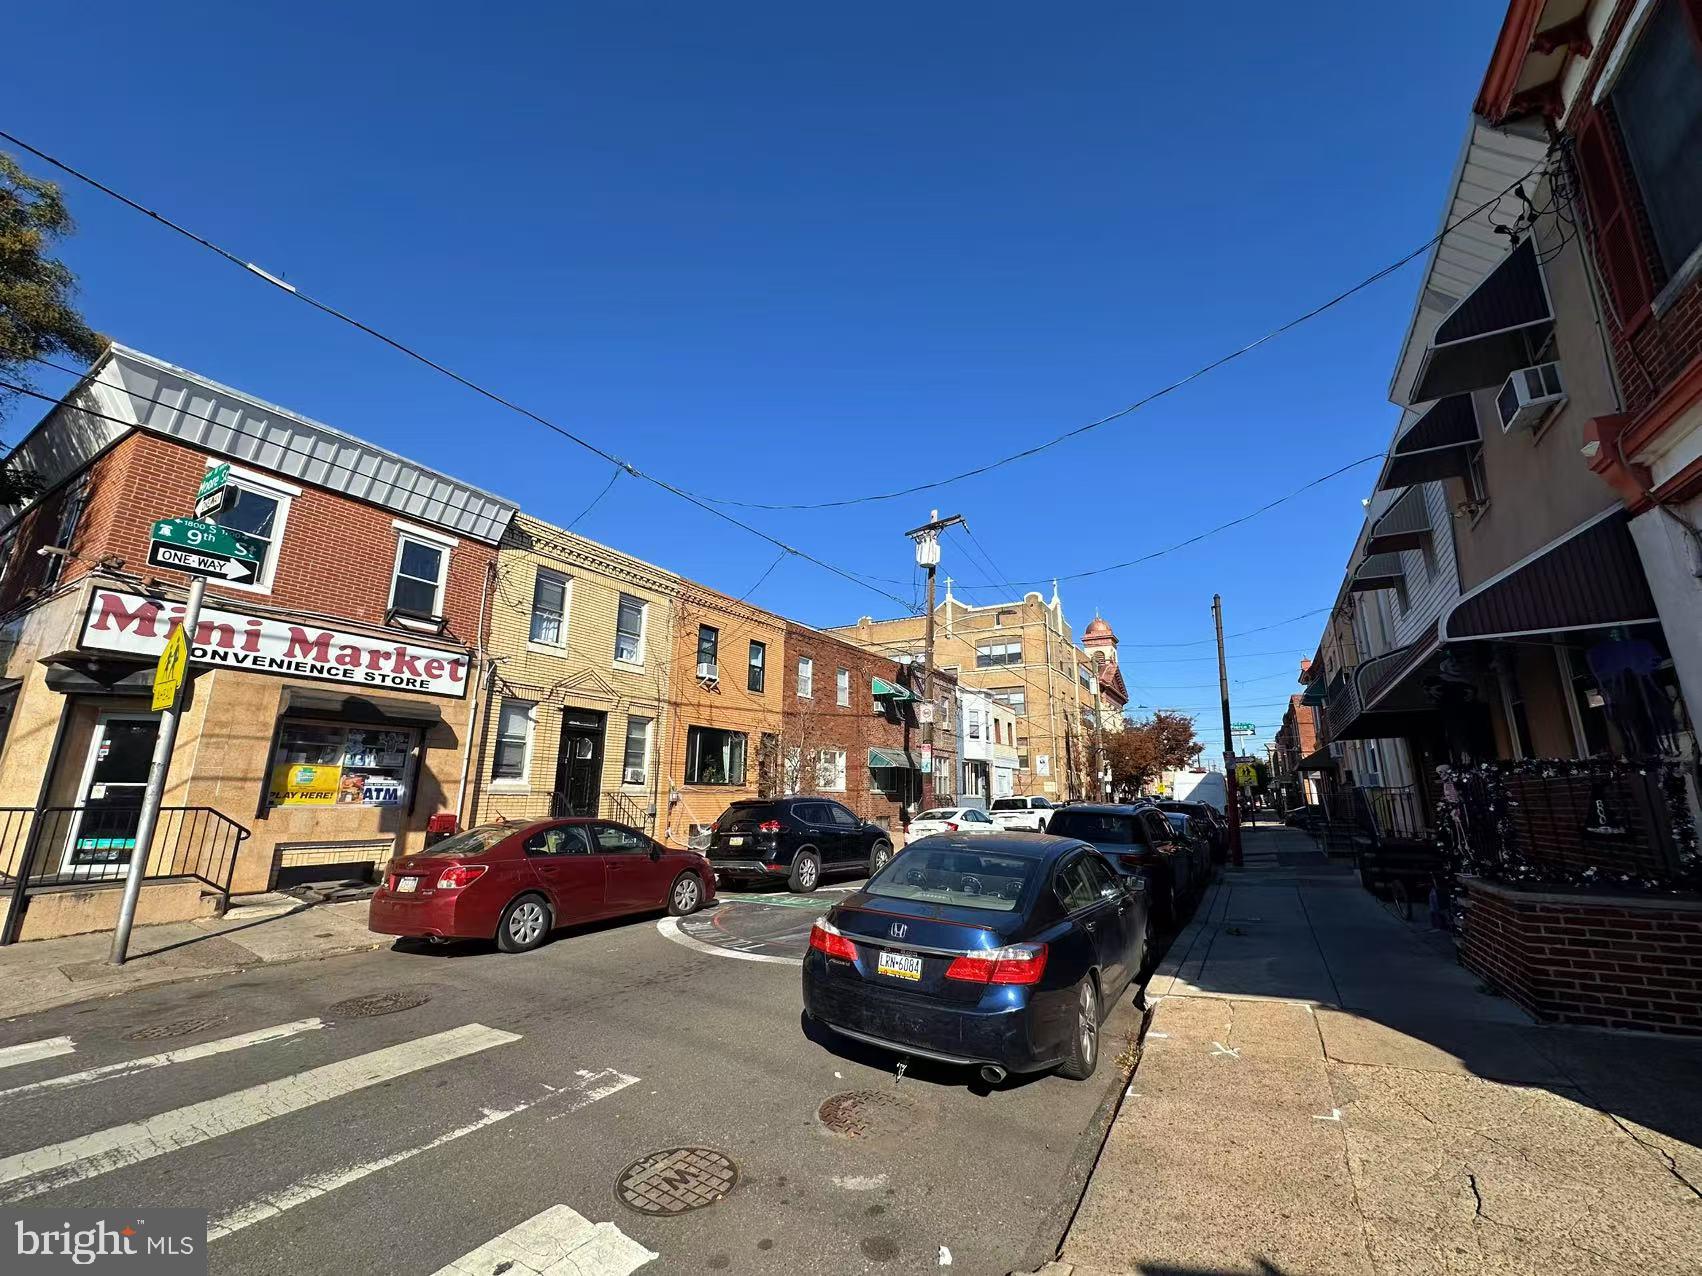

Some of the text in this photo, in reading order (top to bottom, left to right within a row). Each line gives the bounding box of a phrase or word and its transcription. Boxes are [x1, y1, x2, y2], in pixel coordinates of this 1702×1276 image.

[184, 520, 205, 530] 1800
[209, 525, 217, 534] S
[187, 529, 257, 558] 9th St
[90, 593, 466, 682] Mini Market
[190, 646, 431, 690] ONVENIENCE STORE
[270, 791, 334, 800] PLAY HERE!
[363, 787, 398, 801] ATM
